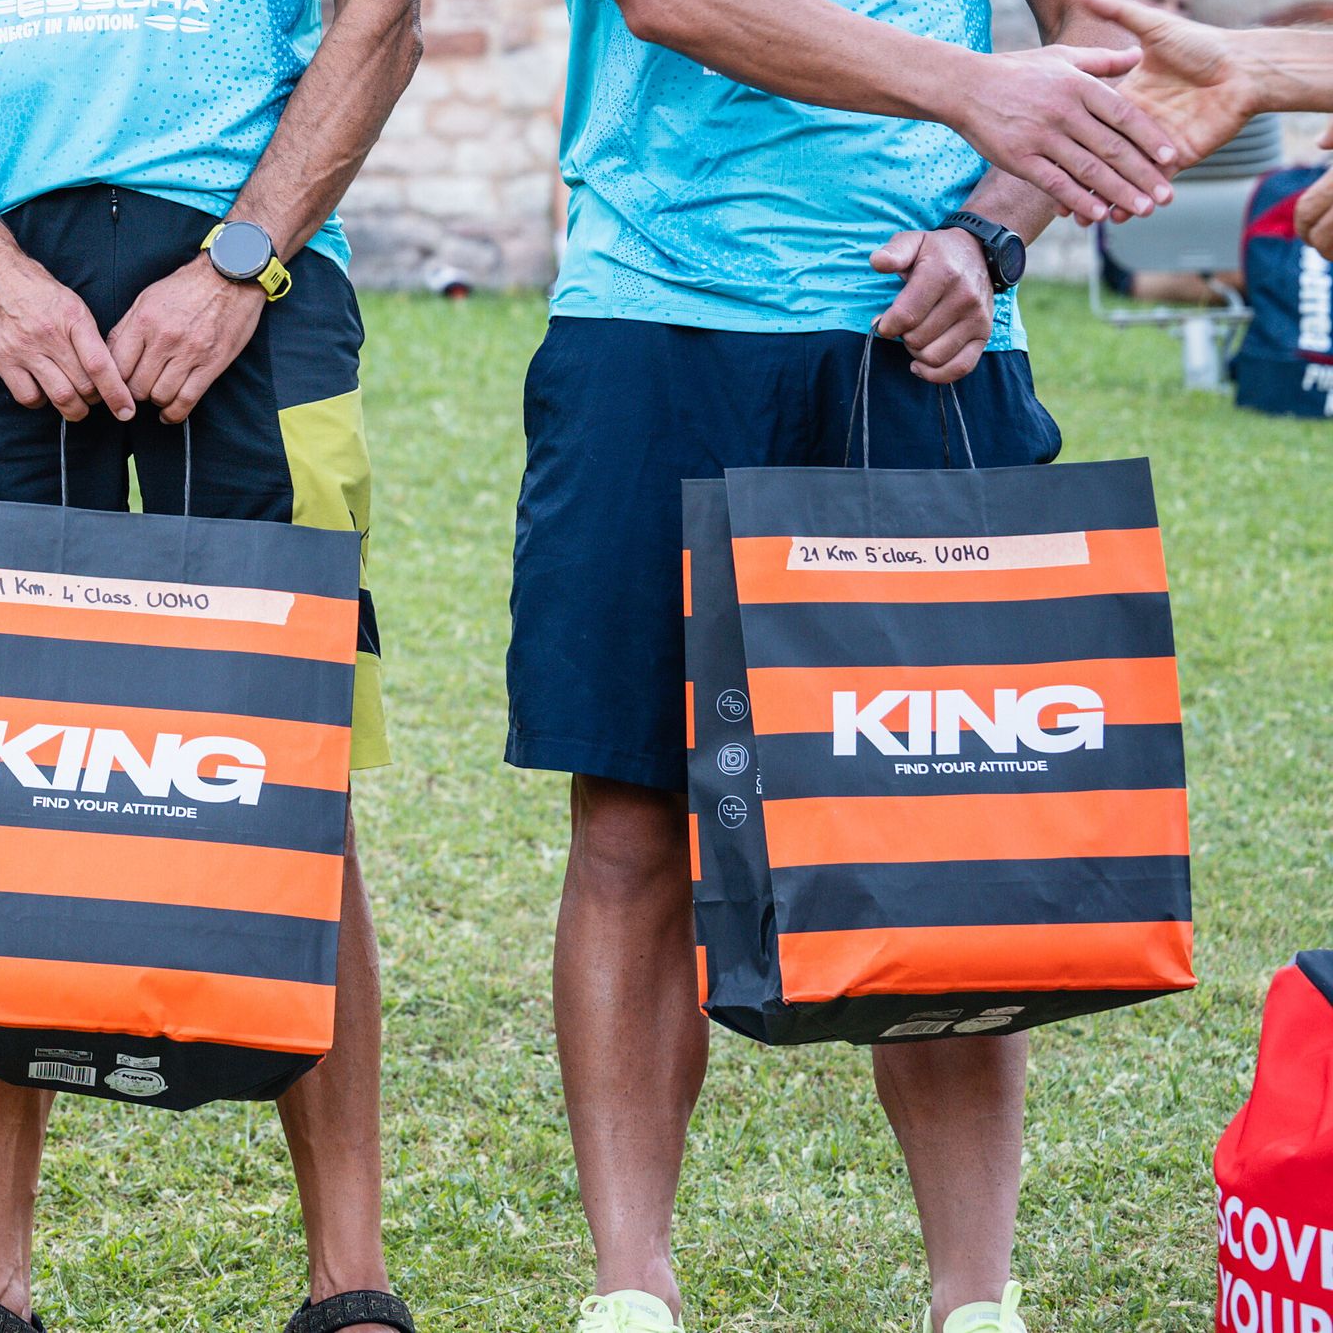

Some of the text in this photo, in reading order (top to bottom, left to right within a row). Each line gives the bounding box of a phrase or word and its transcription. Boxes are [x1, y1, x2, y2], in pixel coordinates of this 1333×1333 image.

[44, 17, 62, 35] IN
[67, 14, 139, 33] MOTION.
[800, 546, 819, 563] 21
[826, 545, 858, 563] Km
[147, 592, 209, 610] UOMO
[832, 684, 1105, 756] KING
[895, 759, 1048, 776] FIND YOUR ATTITUDE
[33, 796, 197, 819] FIND YOUR ATTITUDE
[122, 1073, 153, 1082] KING
